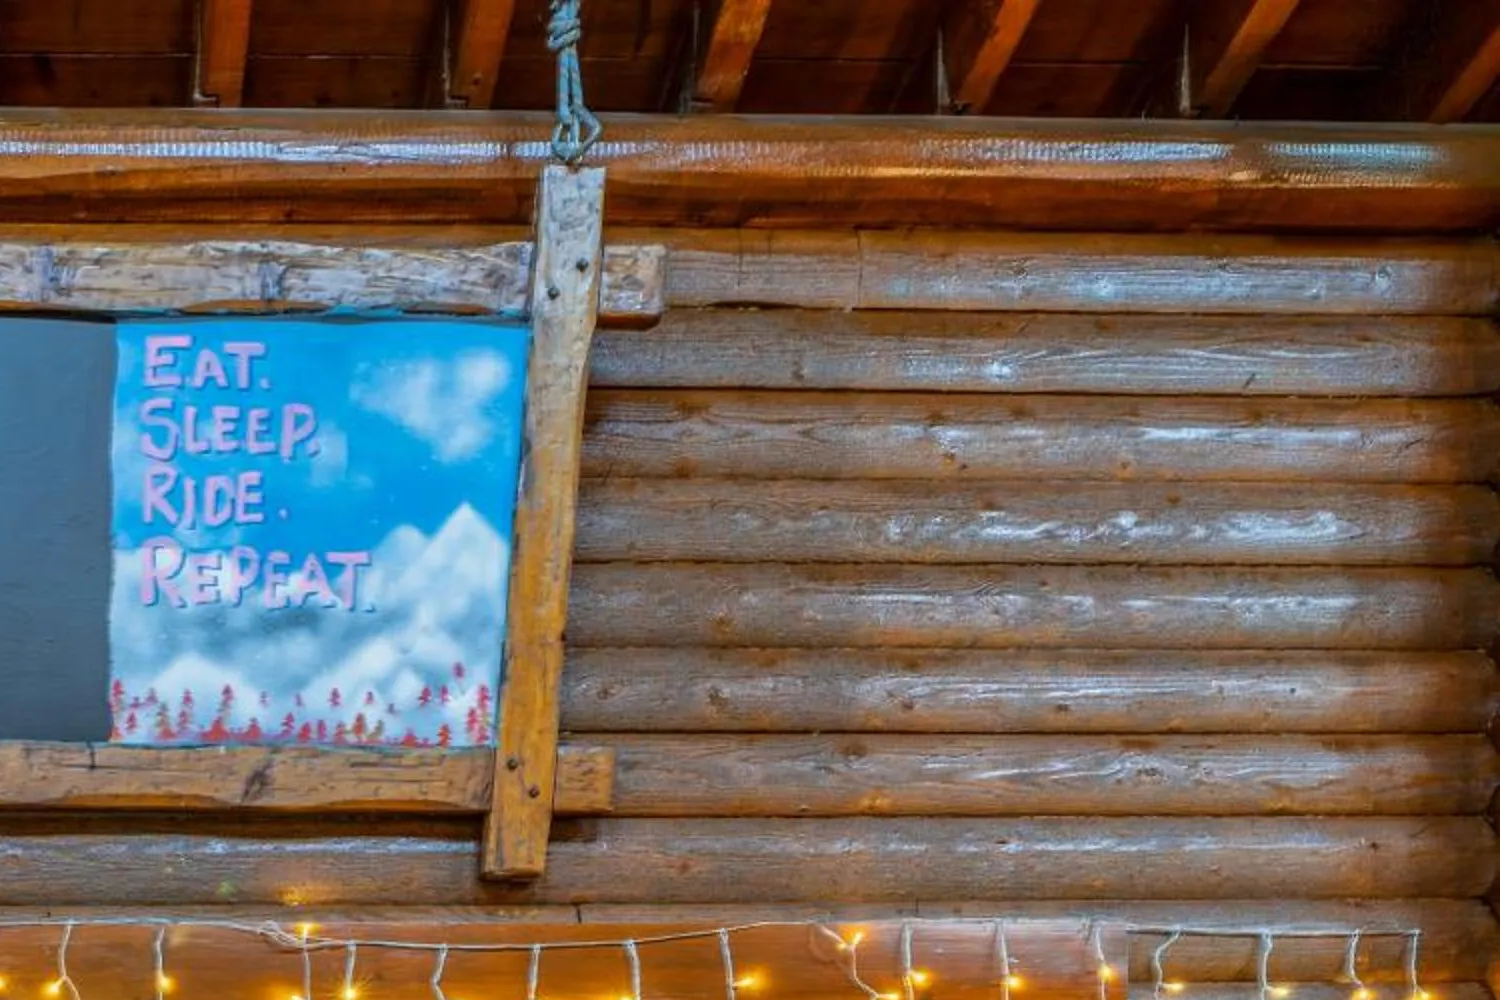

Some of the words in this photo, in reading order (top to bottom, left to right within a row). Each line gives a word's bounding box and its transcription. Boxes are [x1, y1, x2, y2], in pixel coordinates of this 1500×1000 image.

[143, 335, 272, 390] EAT.
[139, 399, 320, 463] SLEEP.
[140, 534, 375, 612] REPEAT.
